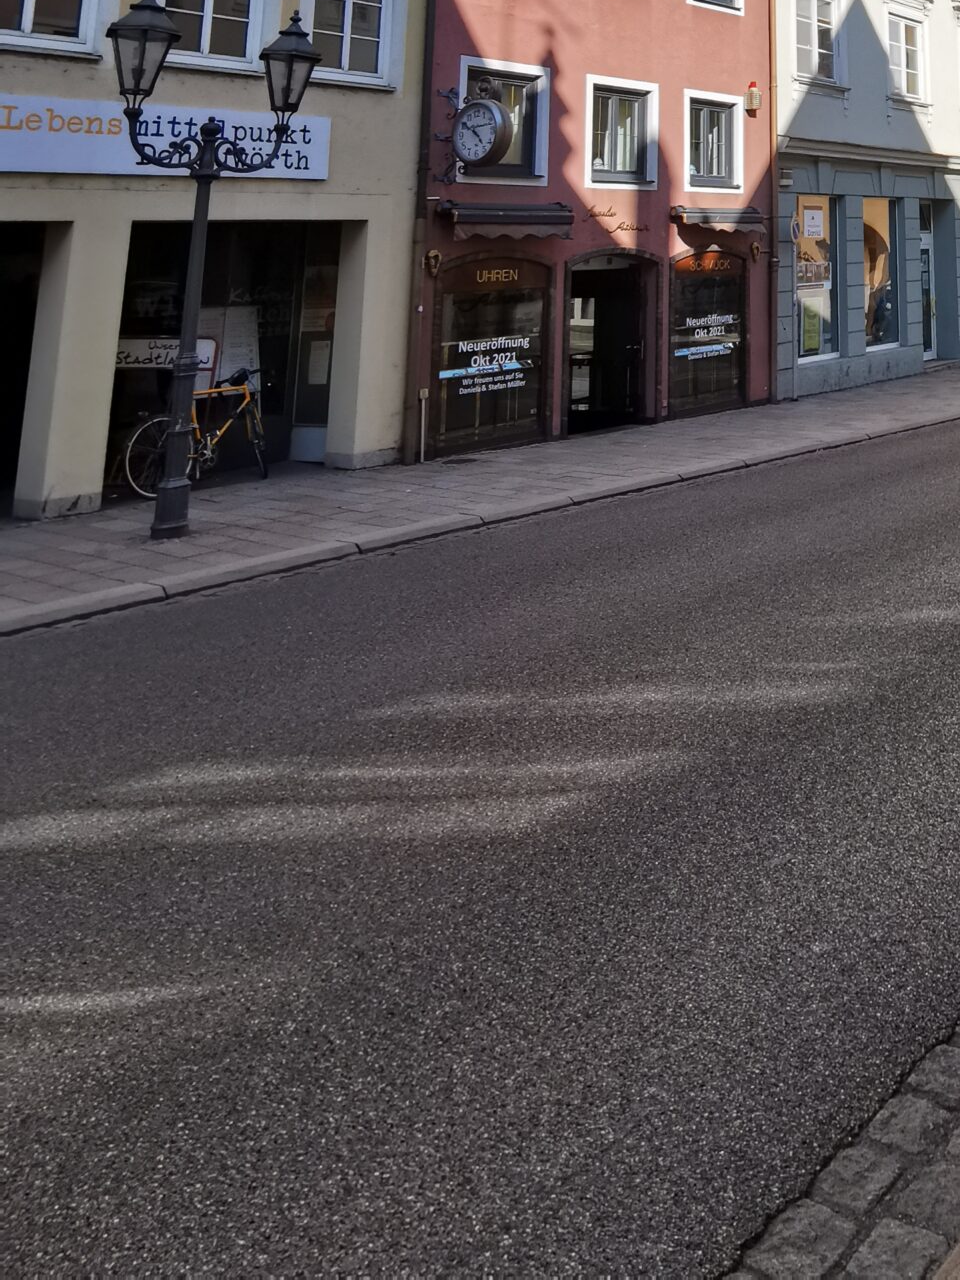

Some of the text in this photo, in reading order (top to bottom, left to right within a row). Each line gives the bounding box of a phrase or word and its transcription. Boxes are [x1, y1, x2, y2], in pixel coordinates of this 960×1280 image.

[477, 269, 518, 283] UHREN
[686, 313, 734, 327] Neueröffnung
[694, 326, 726, 338] Okt 2021
[458, 336, 530, 353] Neueröffnung
[471, 351, 517, 368] Okt 2021
[462, 378, 473, 386] Wir
[474, 376, 493, 384] freuen
[505, 373, 515, 381] auf
[515, 371, 524, 379] Sie
[459, 380, 526, 395] Daniela & Stefan Müller
